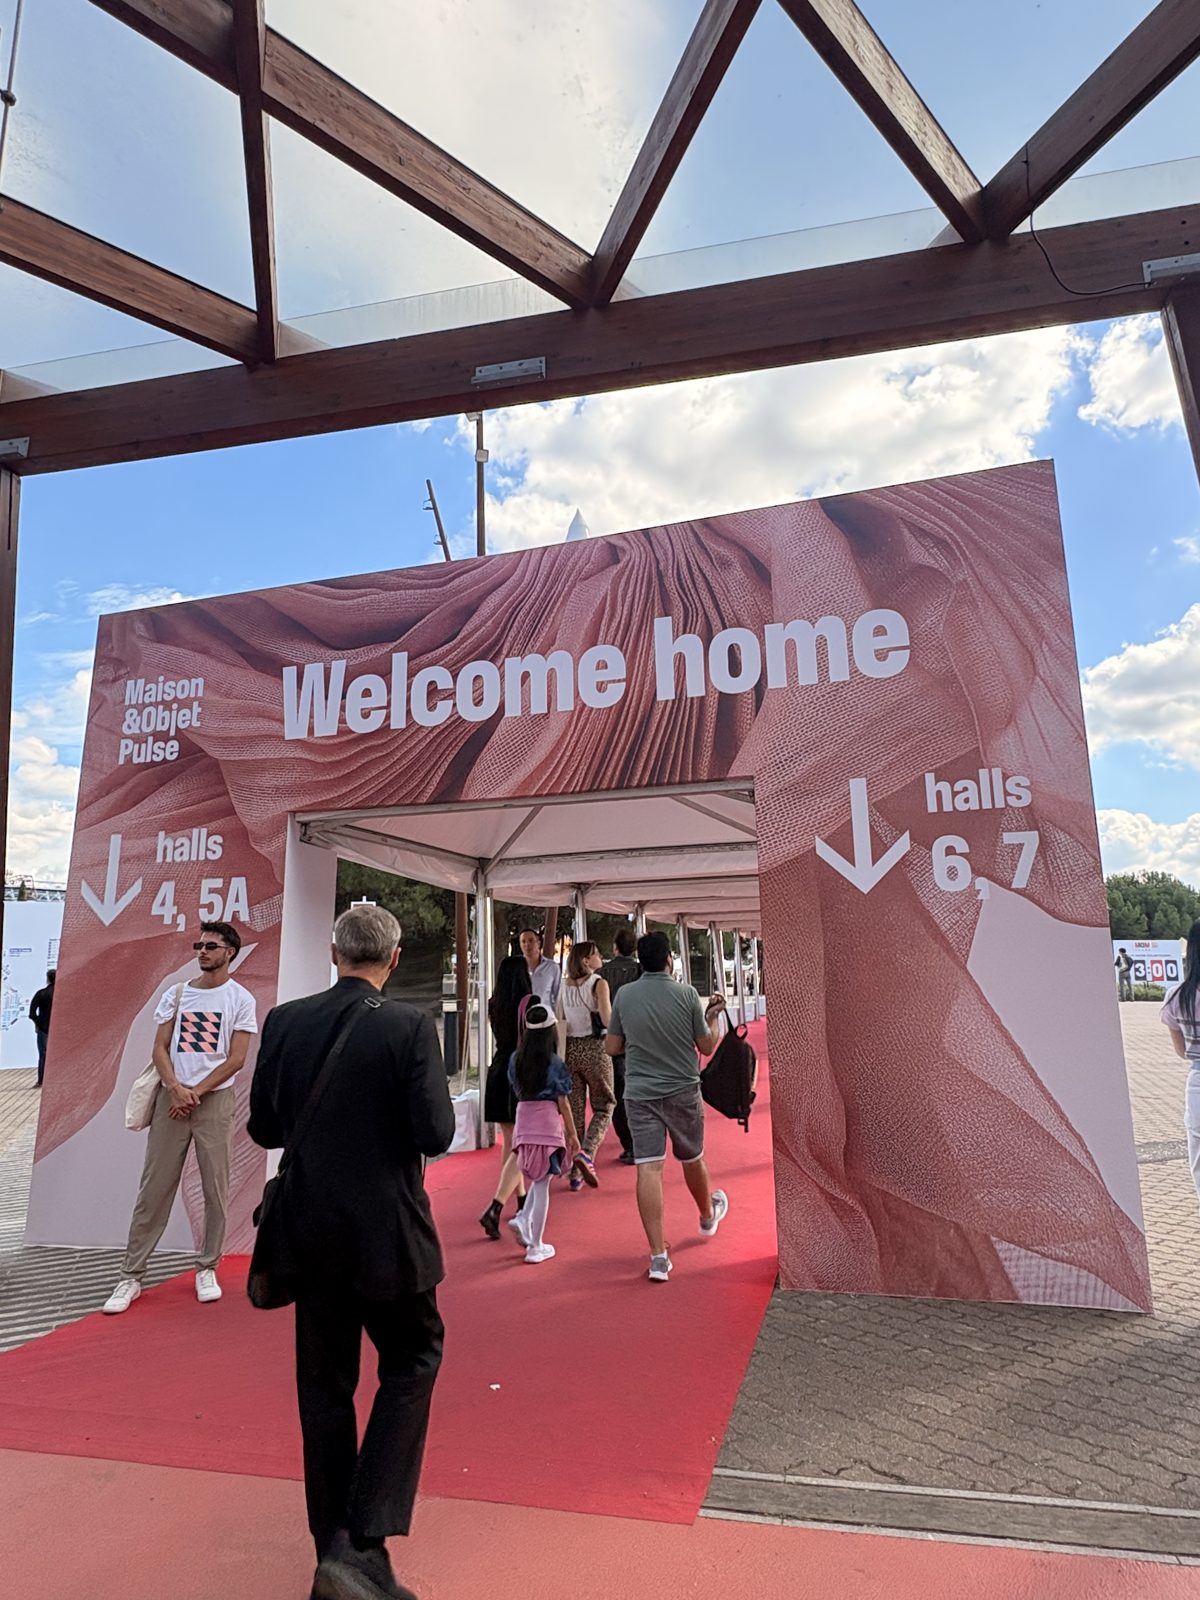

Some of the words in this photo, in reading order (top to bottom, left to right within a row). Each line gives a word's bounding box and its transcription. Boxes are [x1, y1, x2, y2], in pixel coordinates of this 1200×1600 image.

[125, 675, 204, 705] Maison
[282, 644, 626, 740] Welcome
[653, 608, 910, 702] home
[122, 701, 202, 736] &Objet
[118, 736, 179, 765] Pulse
[924, 767, 1032, 813] halls
[156, 828, 223, 863] halls
[931, 834, 990, 900] 6,
[1003, 831, 1039, 890] 7
[151, 880, 185, 932] 4,
[198, 876, 249, 923] 5A
